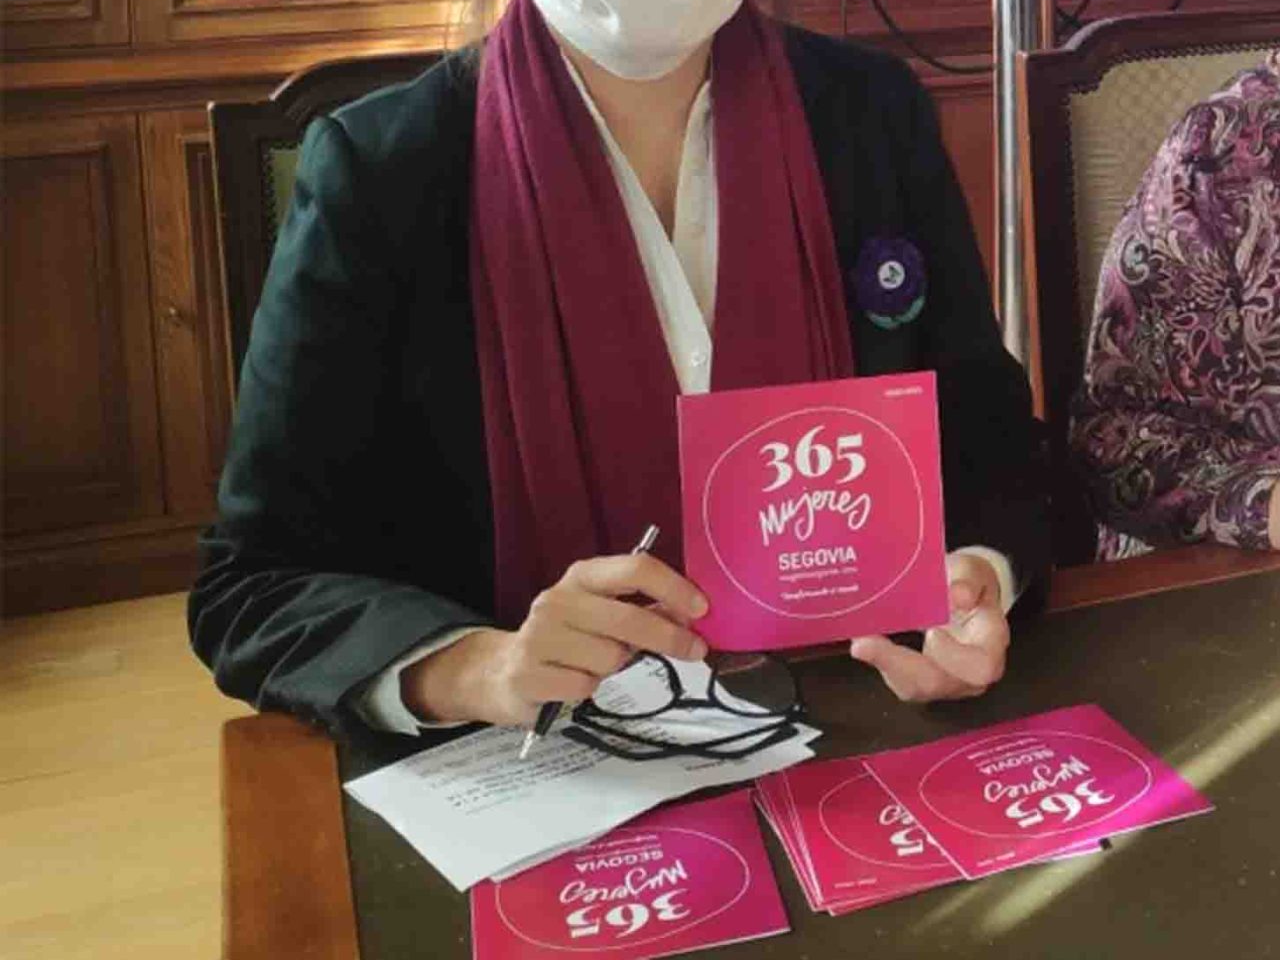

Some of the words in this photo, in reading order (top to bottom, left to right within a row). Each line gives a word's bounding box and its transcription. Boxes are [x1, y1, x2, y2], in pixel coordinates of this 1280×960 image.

[760, 425, 866, 492] 365
[759, 487, 871, 547] Mujeres
[778, 545, 857, 571] SEGOVIA
[979, 748, 1055, 775] SEGOVIA
[983, 755, 1091, 803] Mujeres
[1005, 778, 1115, 828] 365
[560, 859, 688, 903] Mujeres
[575, 849, 663, 873] SEGOVIA
[566, 888, 691, 938] 365
